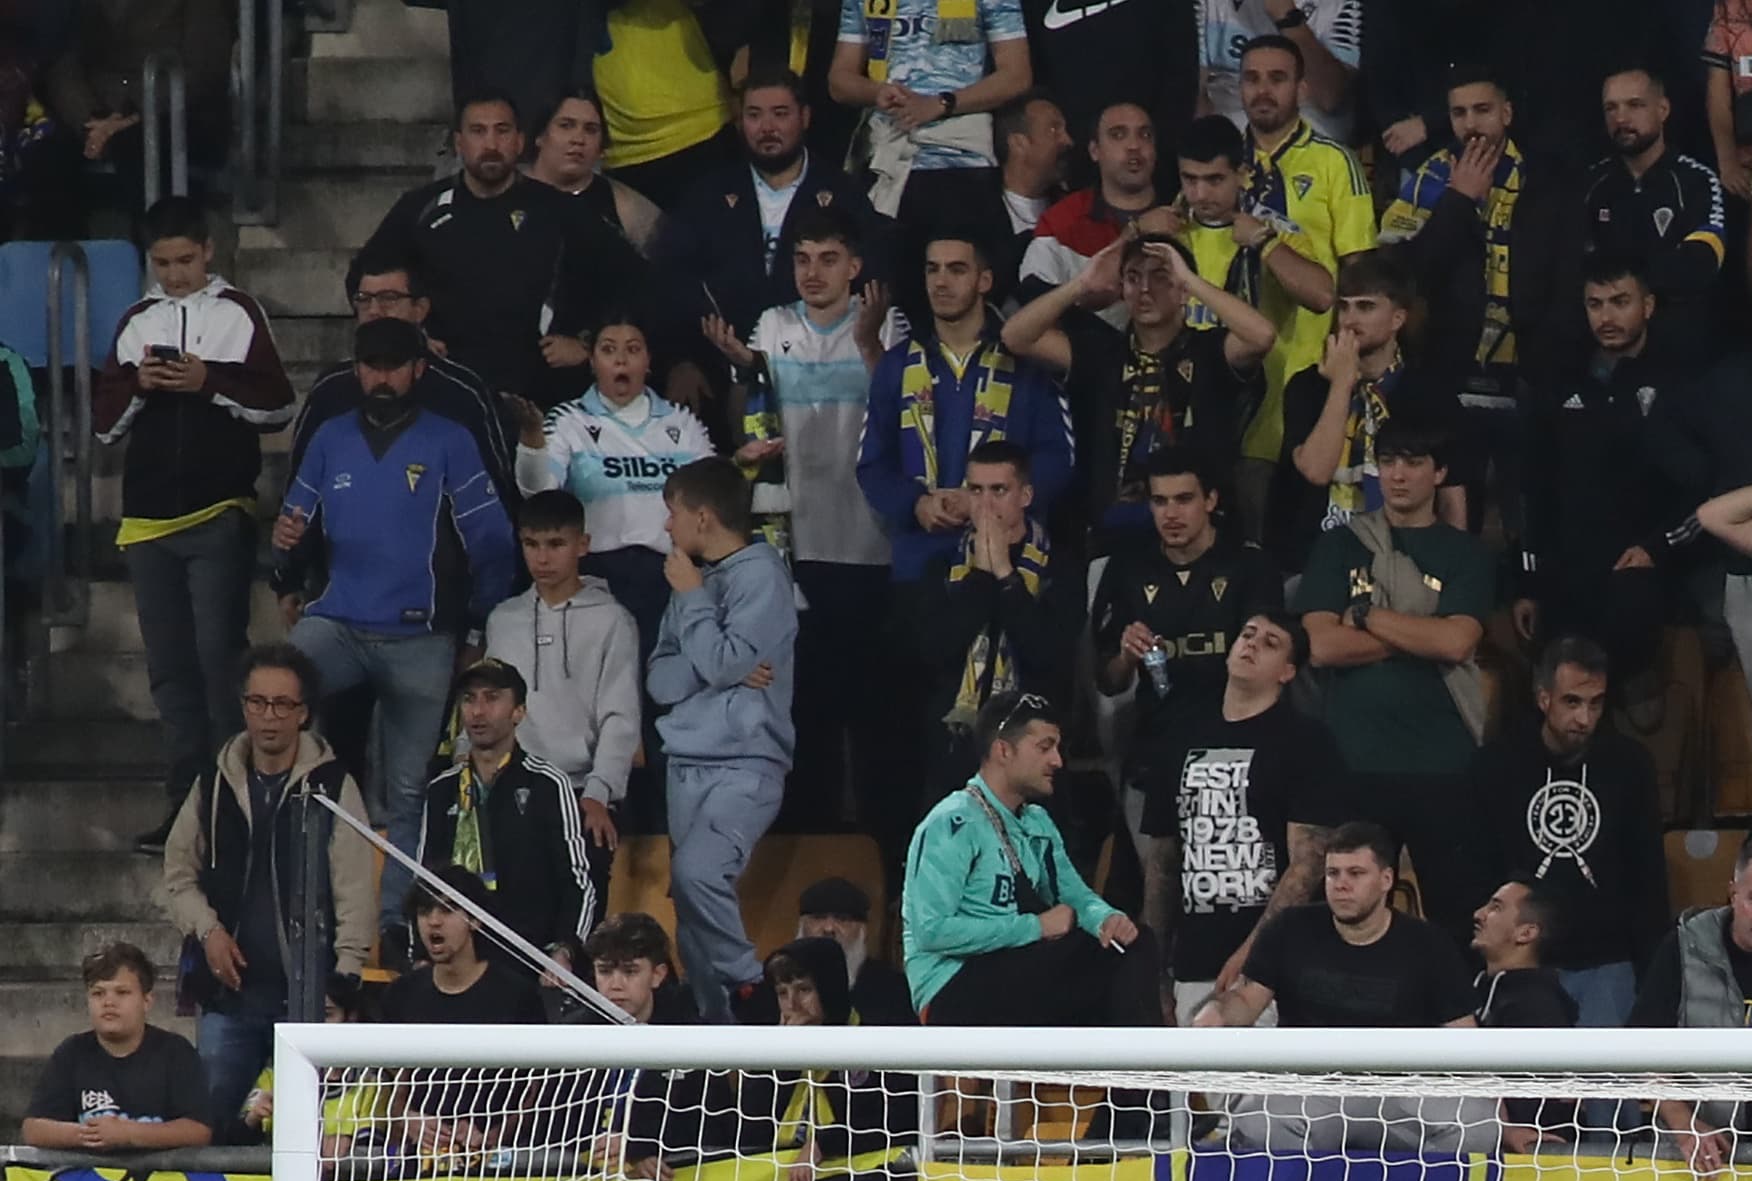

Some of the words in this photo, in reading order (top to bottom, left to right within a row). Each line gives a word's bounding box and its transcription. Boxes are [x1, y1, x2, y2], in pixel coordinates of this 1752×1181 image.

[627, 481, 666, 492] Teleco
[1201, 788, 1237, 817] IN
[1180, 816, 1260, 844] 1978
[1183, 843, 1264, 871] NEW
[1181, 869, 1273, 899] YORK
